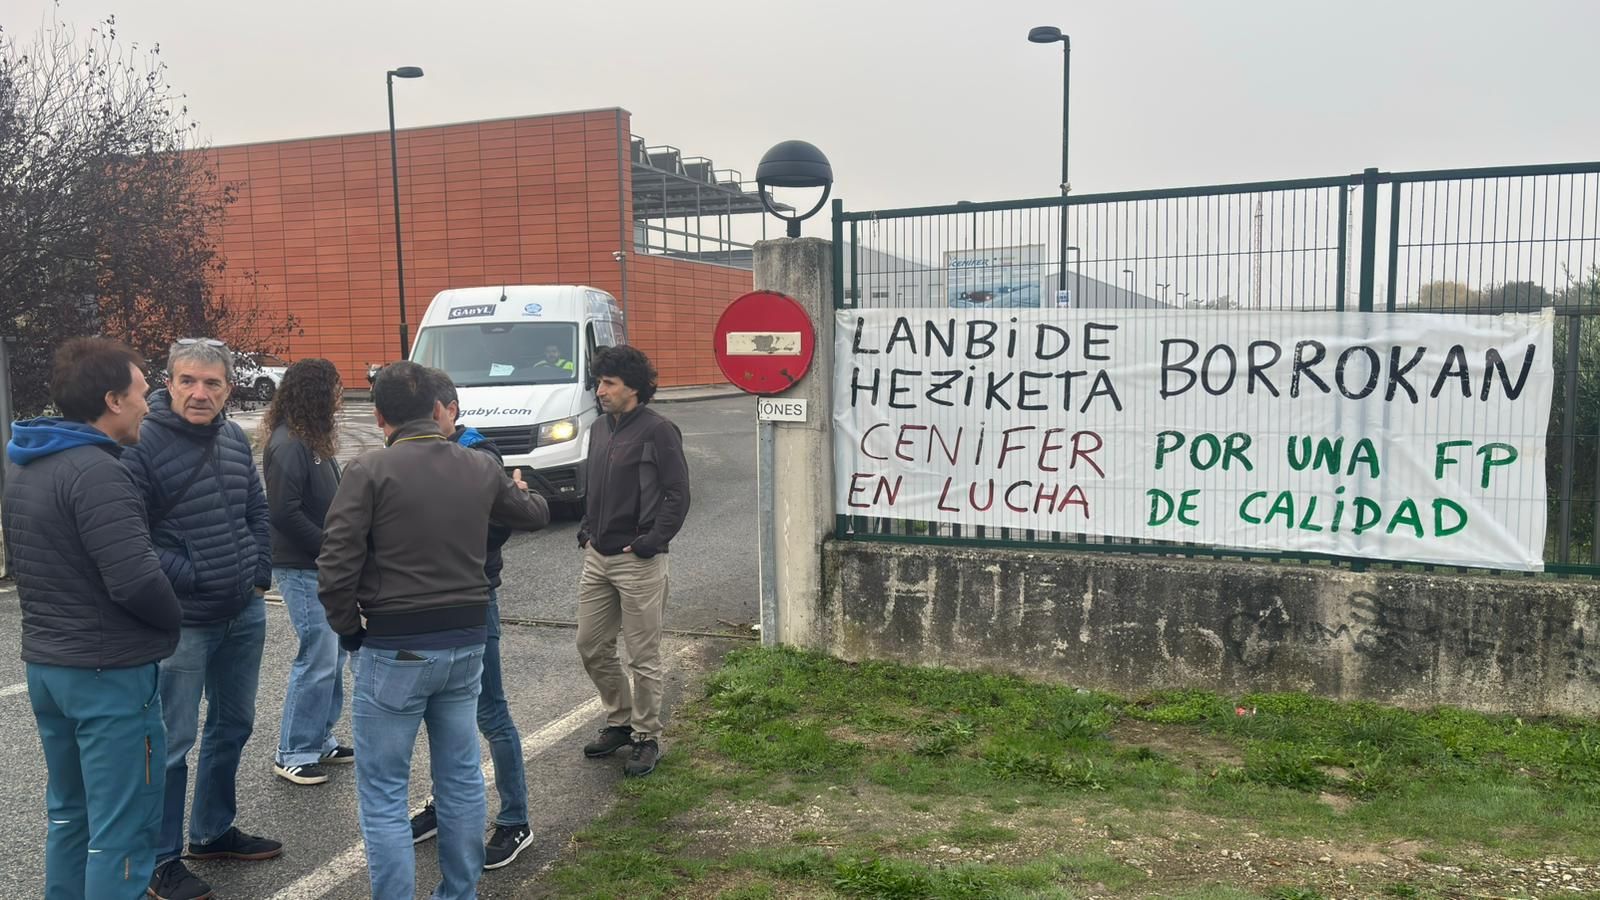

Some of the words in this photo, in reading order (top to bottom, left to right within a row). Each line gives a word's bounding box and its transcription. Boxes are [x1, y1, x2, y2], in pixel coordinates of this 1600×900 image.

[452, 306, 491, 317] GABYL
[1159, 338, 1536, 404] BORROKAN
[460, 407, 532, 418] gabyl.com
[1155, 430, 1254, 473] POR
[1287, 434, 1381, 479] UNA
[1435, 439, 1520, 489] FP
[848, 472, 903, 508] EN
[937, 476, 1091, 520] LUCHA
[1146, 488, 1201, 527] DE
